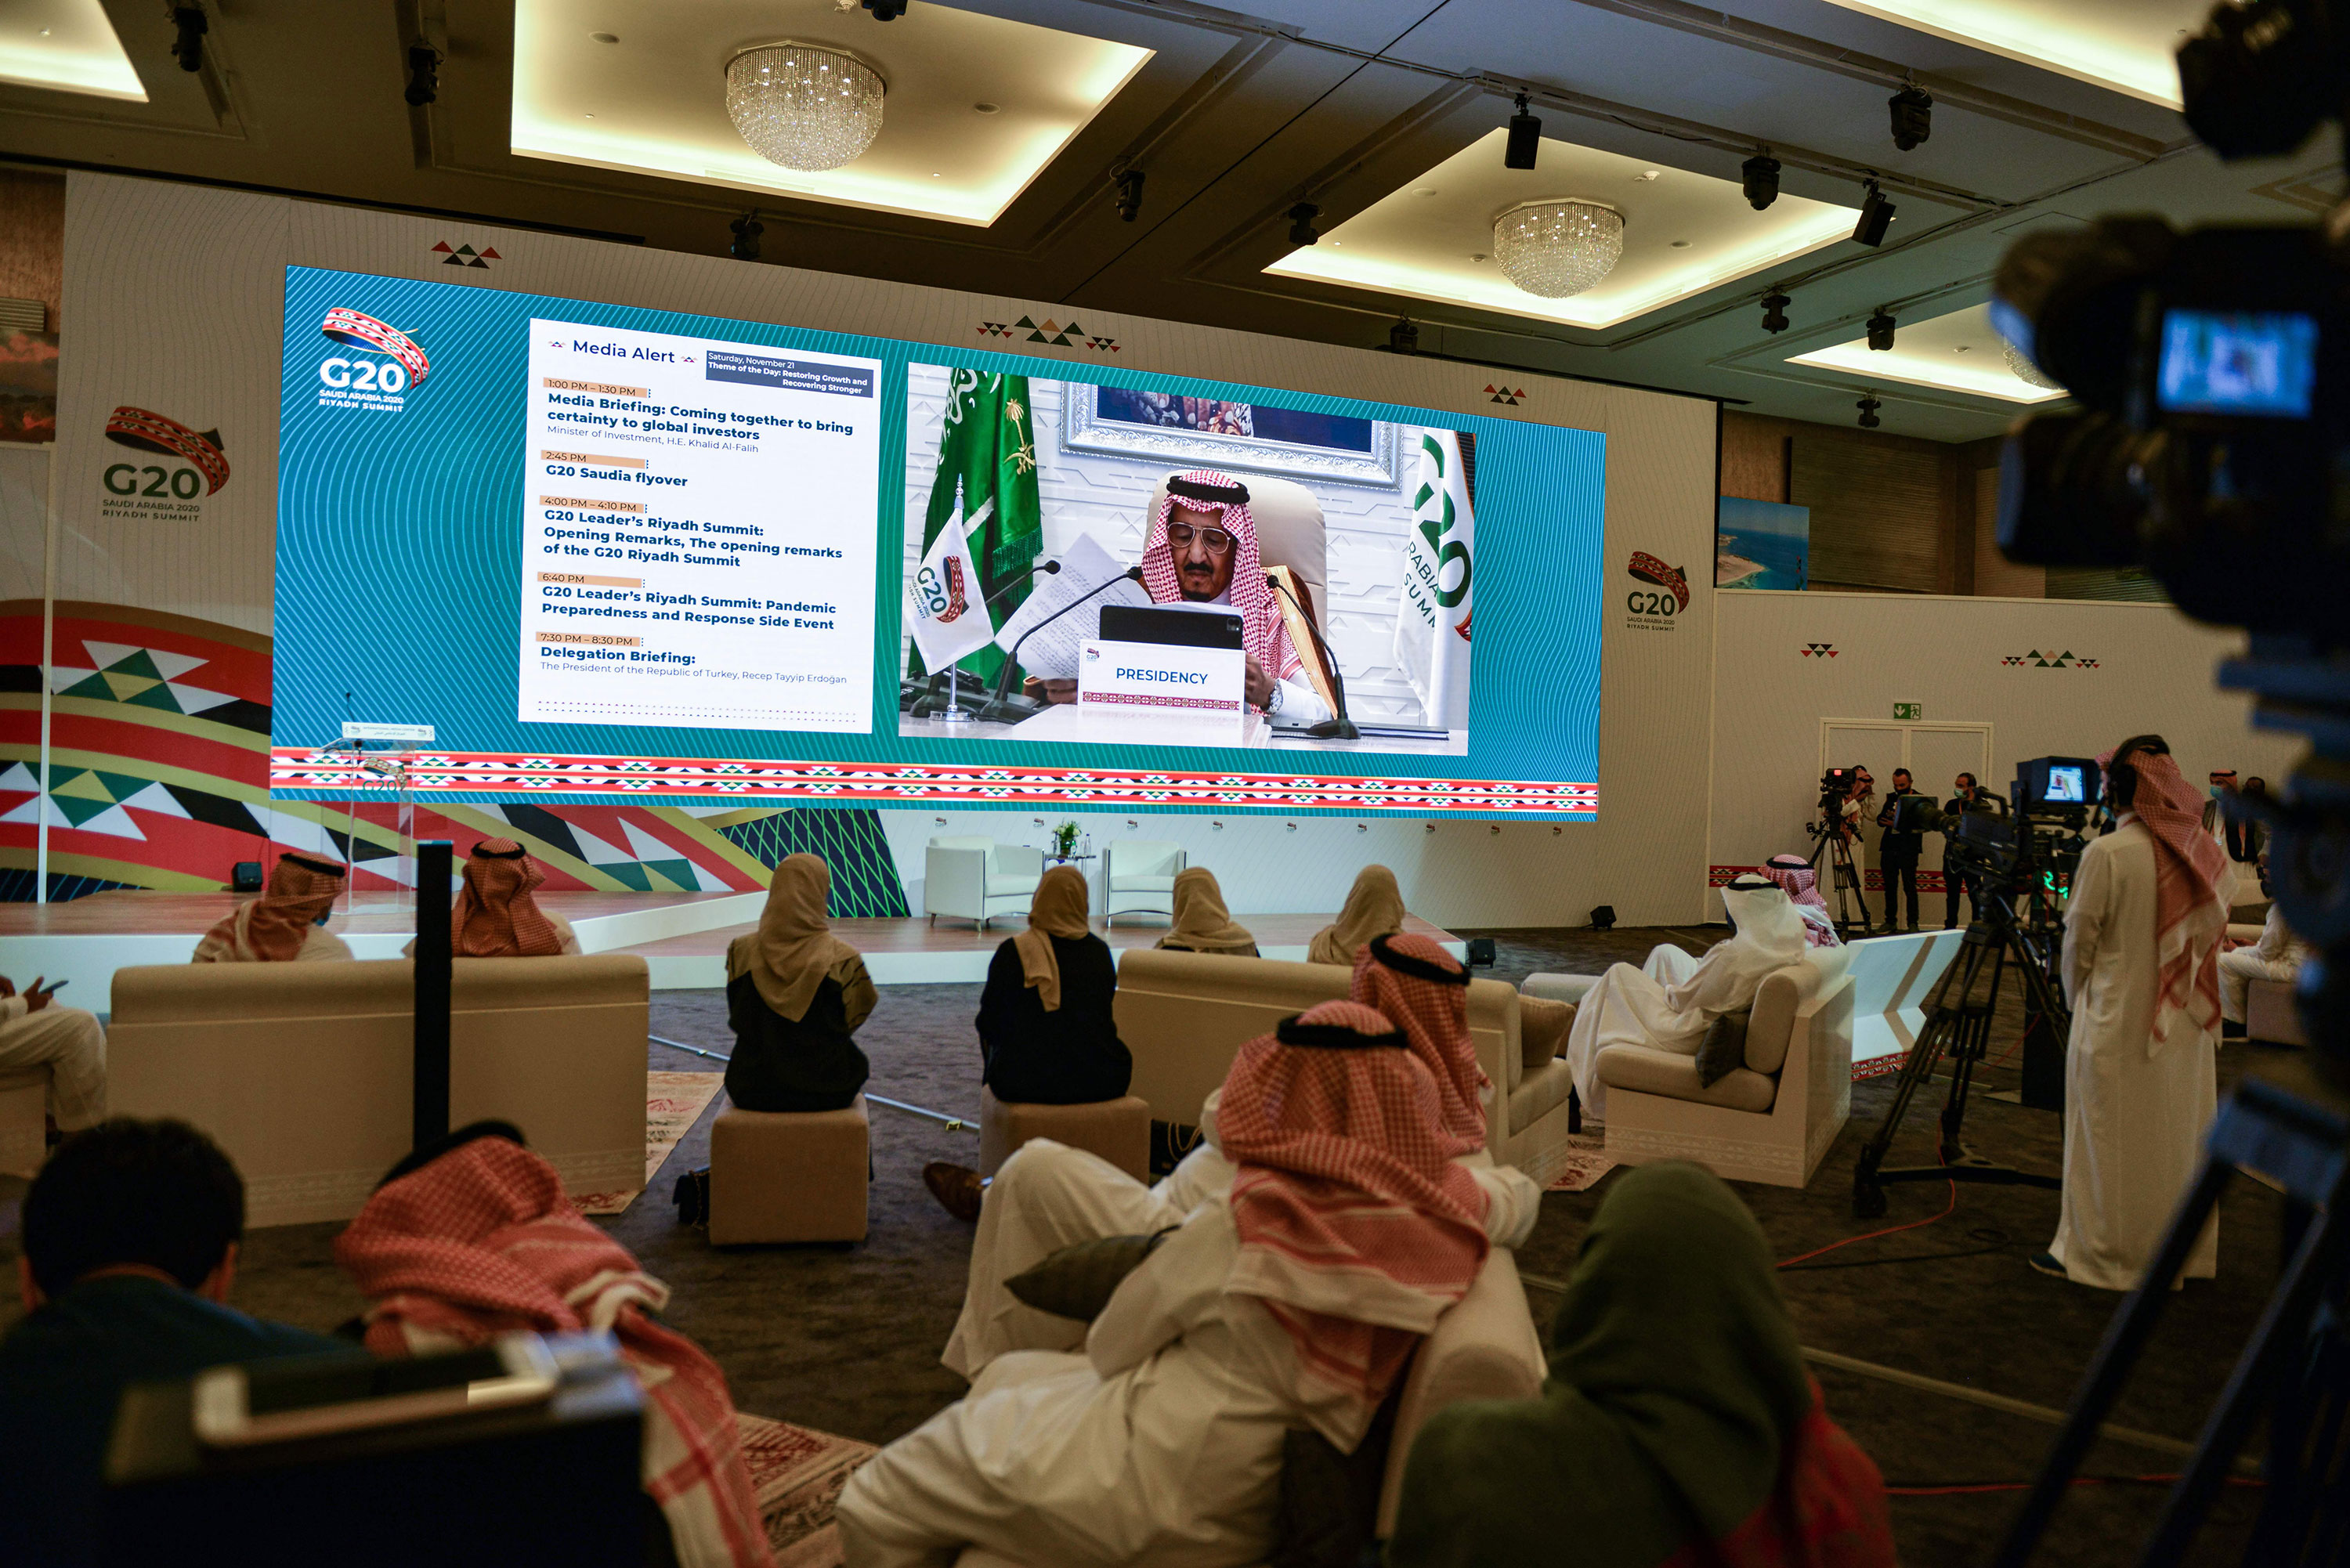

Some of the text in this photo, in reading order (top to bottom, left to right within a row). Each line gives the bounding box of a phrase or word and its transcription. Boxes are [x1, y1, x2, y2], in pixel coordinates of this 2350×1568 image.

[574, 340, 674, 363] Media Alert
[709, 352, 744, 364] Saturday,
[747, 357, 786, 367] November
[320, 358, 405, 392] G20
[708, 362, 736, 371] Theme
[764, 368, 781, 377] Day:
[783, 370, 820, 381] Restoring
[822, 375, 851, 384] Growth
[320, 389, 347, 399] SAUDI
[348, 392, 381, 402] ARABIA
[548, 380, 568, 388] 1:00
[572, 382, 588, 391] PM
[598, 385, 616, 394] 1:30
[620, 388, 635, 396] PM
[783, 379, 862, 394] Recovering Stronger
[319, 399, 403, 412] RIYADH SUMMIT
[549, 393, 853, 435] Media Briefing: Coming together to bring
[548, 412, 760, 439] certainty to global investors
[548, 426, 588, 436] Minister
[605, 431, 664, 445] Investment,
[667, 437, 685, 446] H.E.
[689, 439, 719, 449] Khalid
[722, 443, 758, 453] Al-Falih
[547, 452, 567, 461] 2:45
[103, 464, 201, 500] G20
[547, 465, 688, 486] G20 Saudia flyover
[103, 499, 133, 508] SAUDI
[136, 501, 174, 511] ARABIA
[545, 497, 568, 506] 4:00
[571, 499, 587, 508] PM
[598, 501, 617, 510] 4:10
[620, 503, 636, 511] PM
[103, 509, 199, 522] RIYADH SUMMIT
[545, 510, 573, 521] G20
[649, 518, 698, 531] Riyadh
[703, 522, 764, 536] Summit:
[544, 527, 842, 558] Opening Remarks, The opening remarks
[544, 544, 740, 566] of the G20 Riyadh Summit
[543, 573, 565, 582] 6:40
[1408, 540, 1438, 598] RABIA
[543, 587, 572, 598] G20
[646, 592, 696, 605] Riyadh
[702, 597, 761, 609] Summit:
[767, 601, 836, 613] Pandemic
[917, 567, 947, 612] G20
[1627, 591, 1675, 616] G20
[543, 603, 833, 630] Preparedness and Response Side Event
[541, 634, 562, 642] 7:30
[592, 636, 613, 645] 8:30
[541, 647, 696, 666] Delegation Briefing:
[563, 663, 611, 673] President
[647, 667, 690, 677] Republic
[706, 670, 739, 680] Turkey,
[743, 672, 772, 681] Recep
[776, 673, 804, 683] Tayyip
[808, 675, 847, 685] Erdoğan
[1116, 668, 1208, 685] PRESIDENCY
